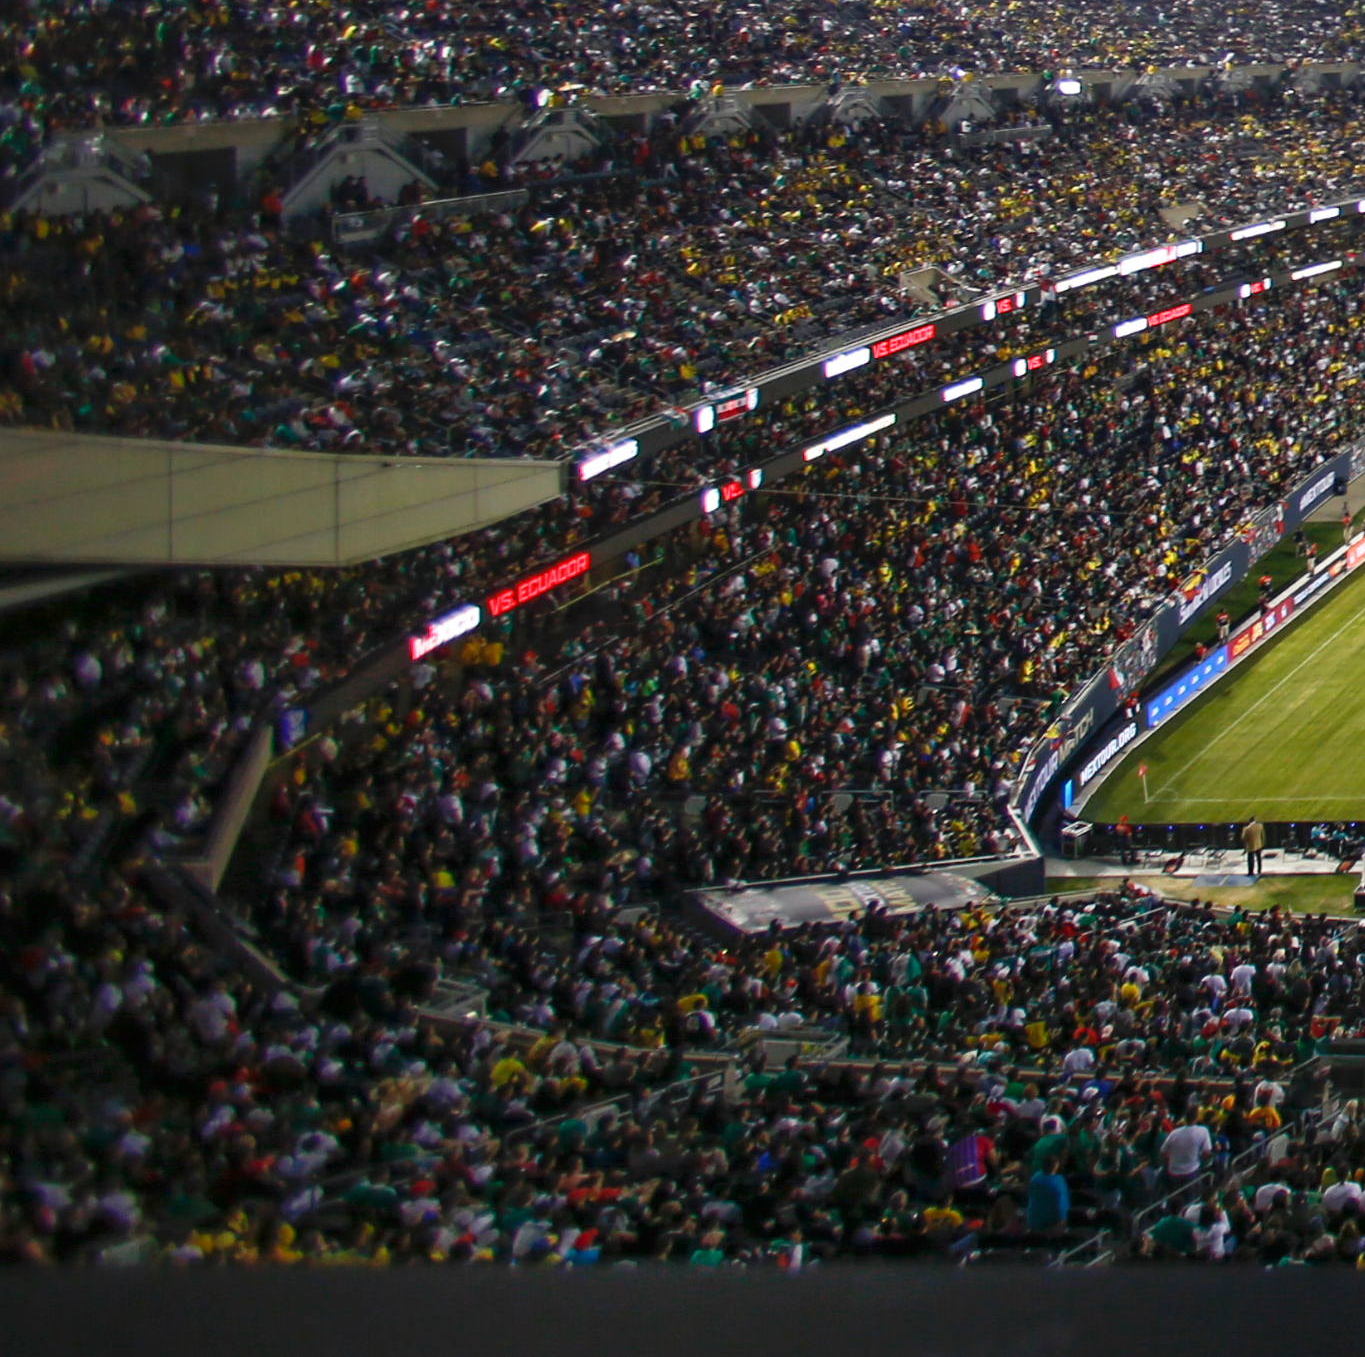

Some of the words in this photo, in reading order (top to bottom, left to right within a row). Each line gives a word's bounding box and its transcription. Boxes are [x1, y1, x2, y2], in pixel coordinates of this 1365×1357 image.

[889, 324, 935, 354] ECUADOR
[488, 588, 516, 617] VS.
[516, 552, 590, 604] ECUADOR
[1080, 722, 1138, 786] MEXTOUR.ORG
